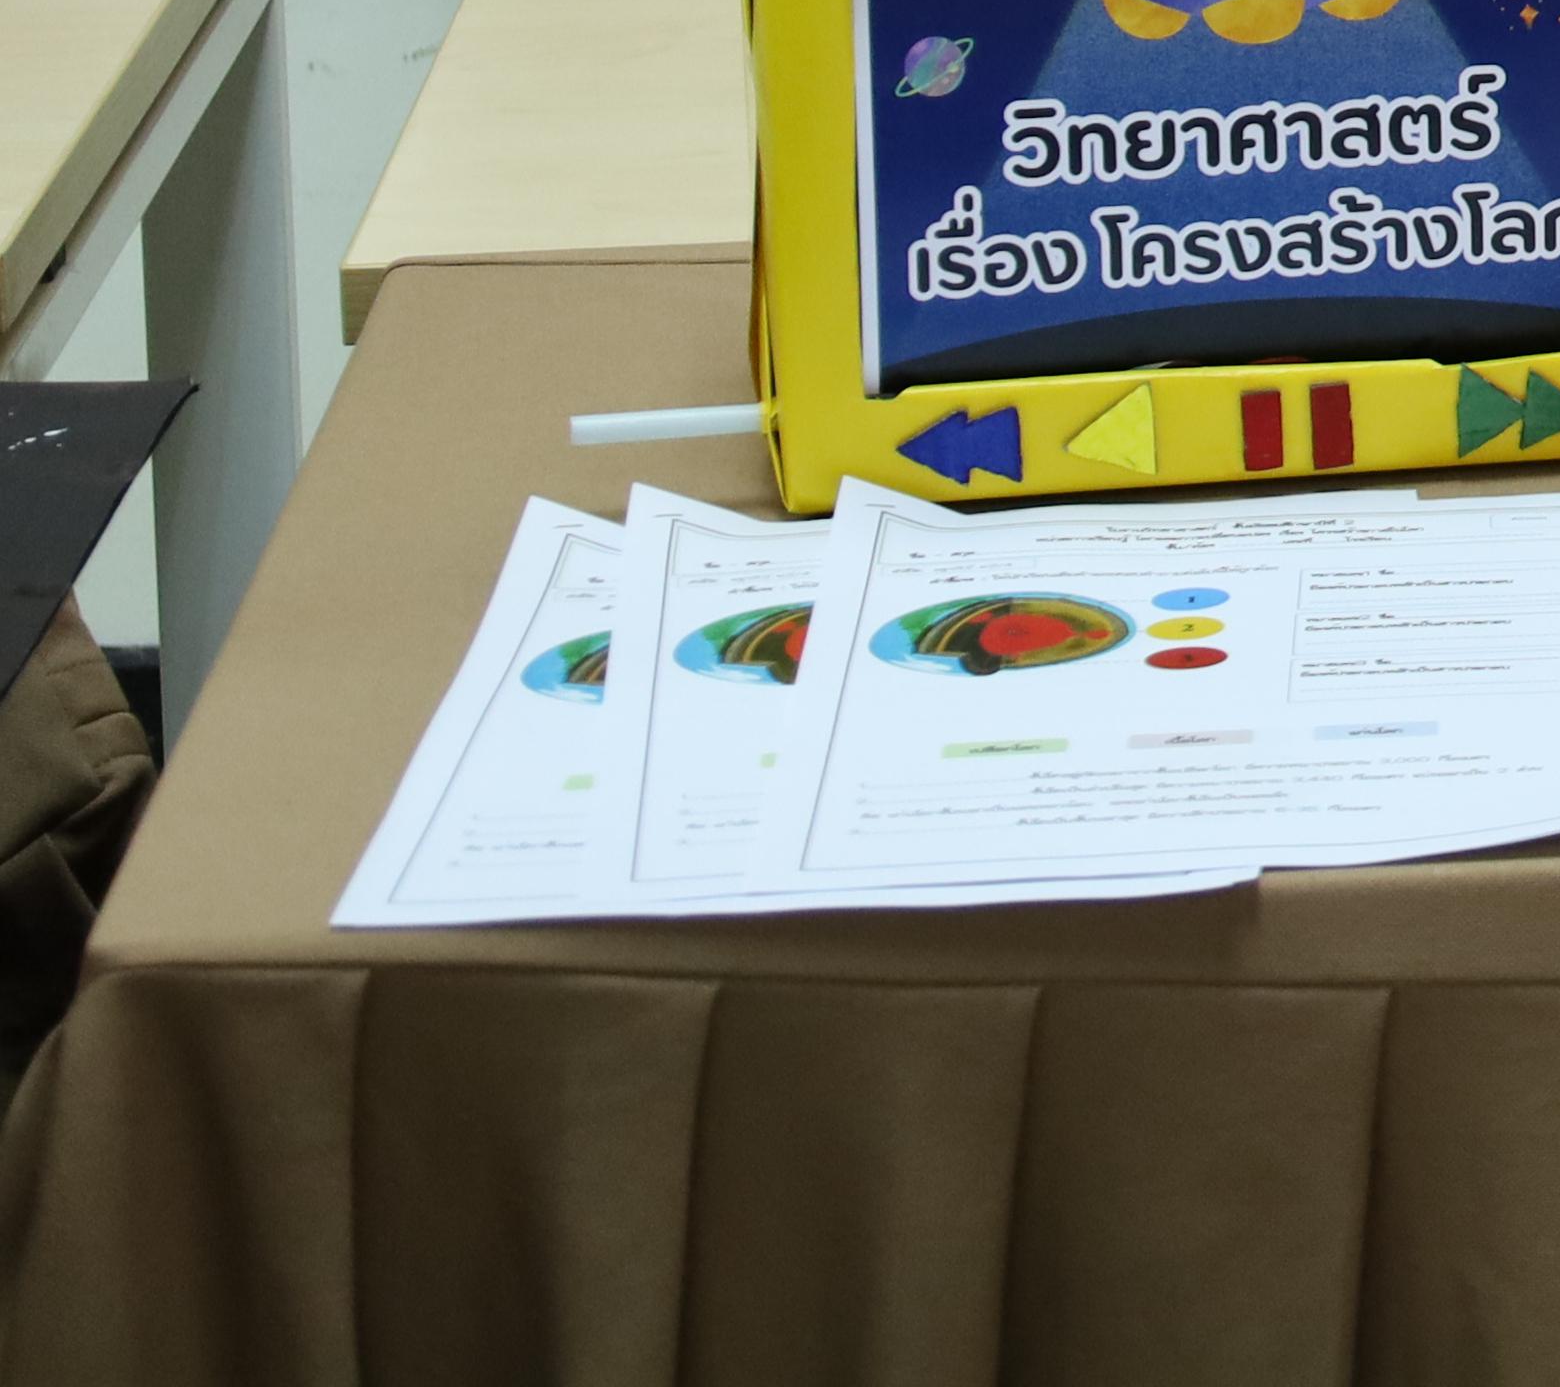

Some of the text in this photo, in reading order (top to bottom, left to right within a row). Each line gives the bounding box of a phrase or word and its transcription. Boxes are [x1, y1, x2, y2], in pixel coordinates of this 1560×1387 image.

[1004, 66, 1505, 185] วิทยาศาสตร์
[909, 187, 1086, 300] เรื่อง
